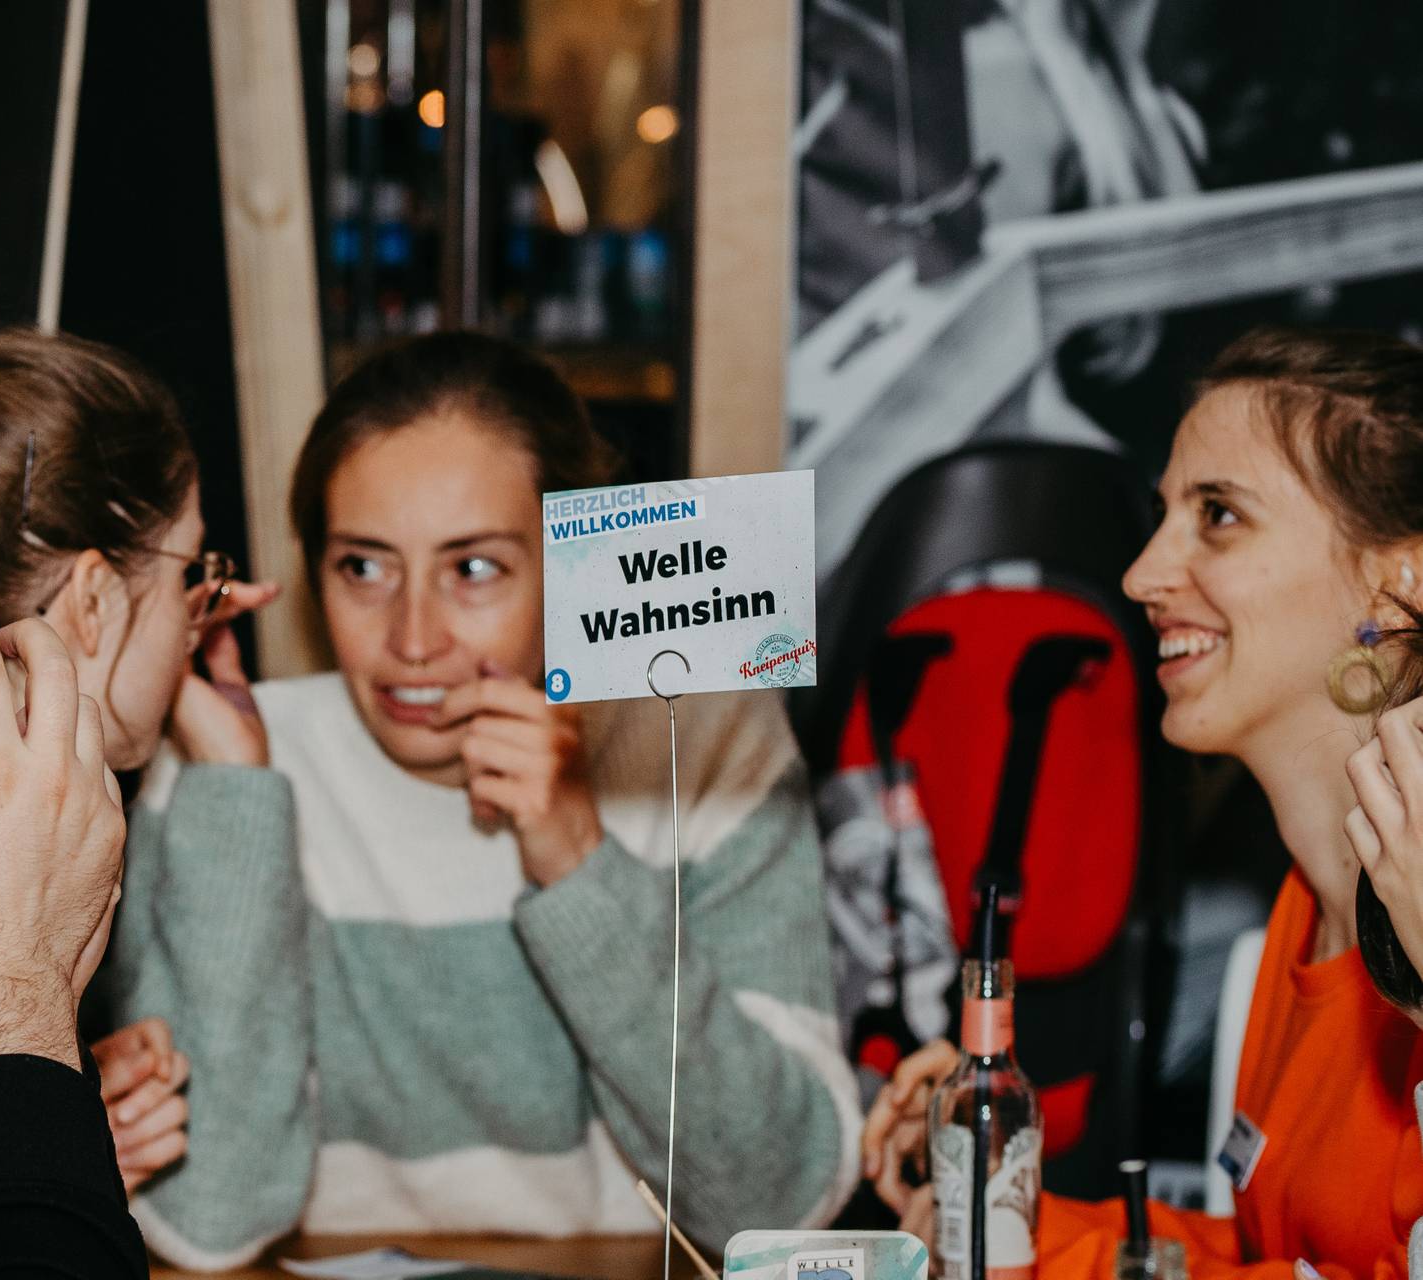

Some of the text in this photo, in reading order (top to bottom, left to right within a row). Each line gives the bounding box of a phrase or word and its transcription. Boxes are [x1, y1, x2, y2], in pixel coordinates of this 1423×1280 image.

[545, 486, 646, 521] HERZLICH
[551, 500, 696, 540] WILLKOMMEN
[618, 540, 728, 585] Welle
[580, 586, 776, 644] Wahnsinn
[739, 639, 817, 680] Kneipenquiz
[551, 673, 565, 693] 8
[797, 1259, 854, 1269] WELLE
